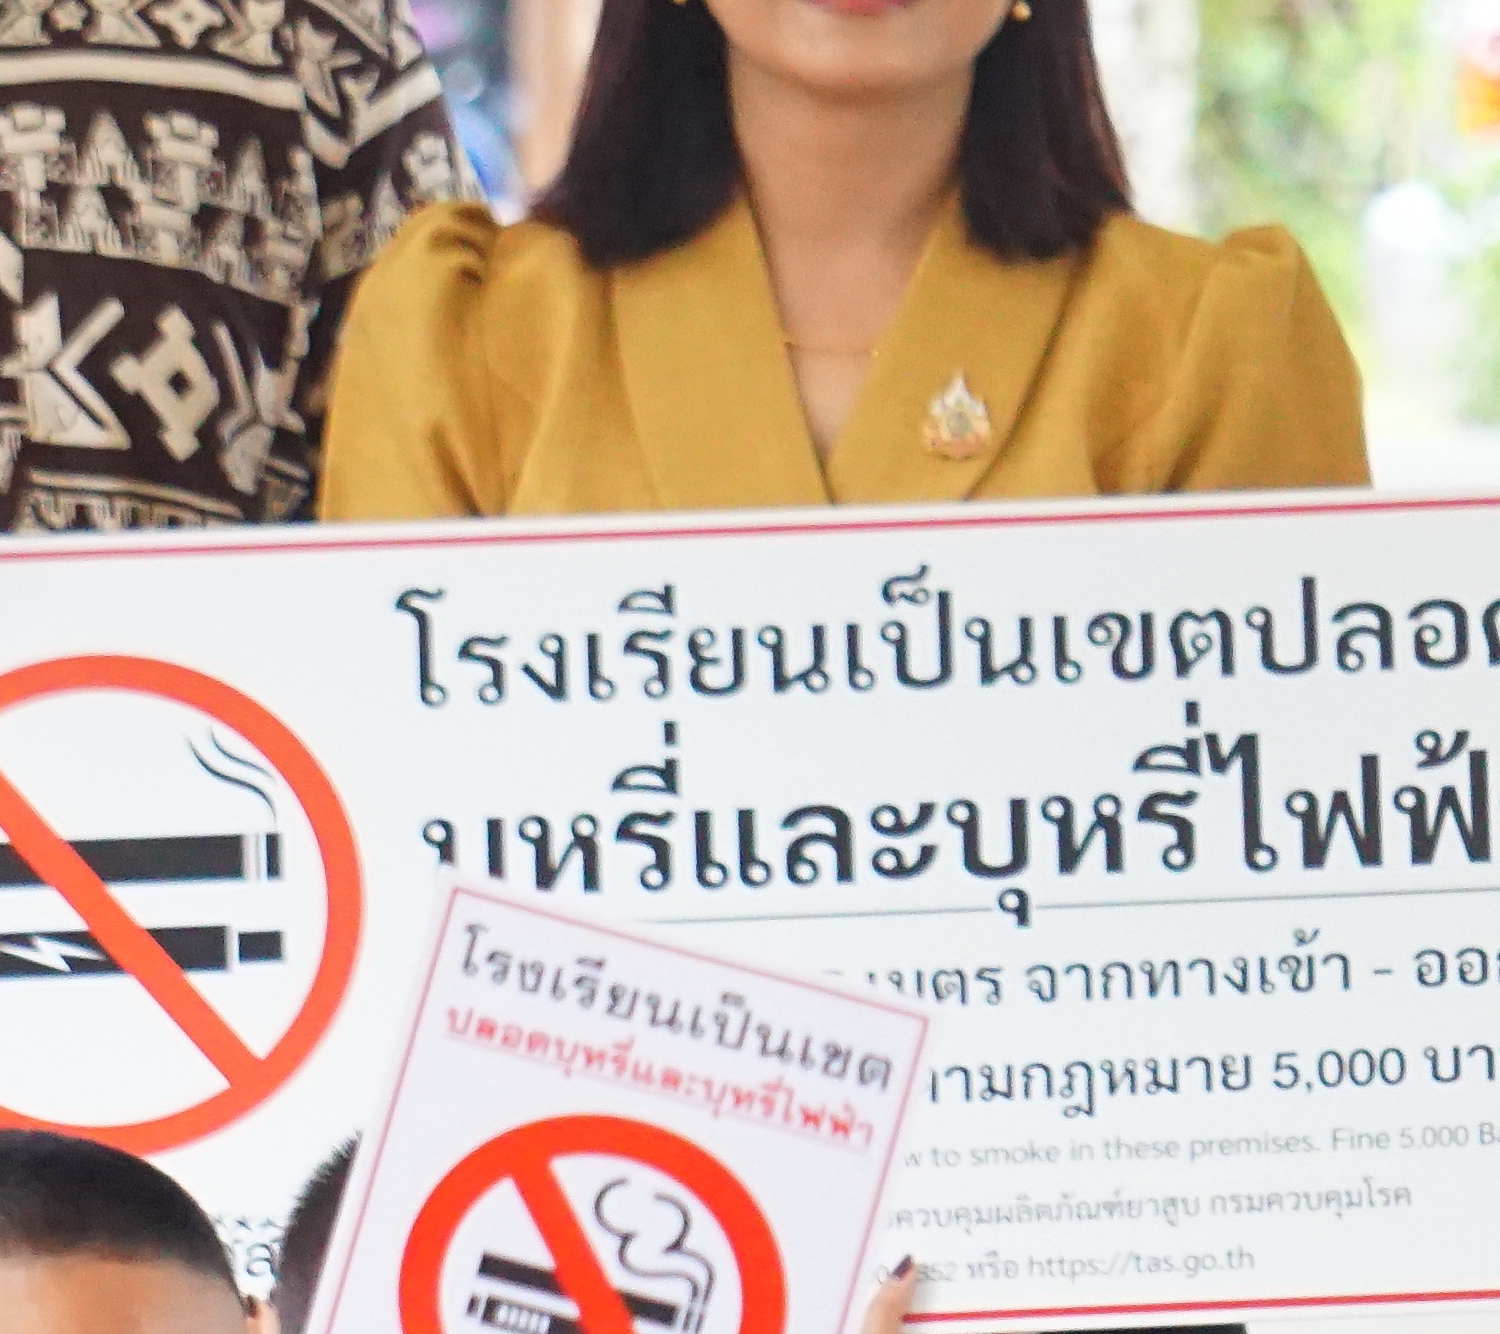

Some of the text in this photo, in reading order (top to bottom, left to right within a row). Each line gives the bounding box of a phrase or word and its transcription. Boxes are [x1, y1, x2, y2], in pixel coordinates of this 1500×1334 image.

[1026, 928, 1352, 1005] จากทางเข้า
[1272, 1046, 1408, 1094] 5,000
[930, 1145, 961, 1168] to
[970, 1140, 1061, 1166] smoke
[1070, 1138, 1094, 1162] in
[1103, 1135, 1181, 1161] these
[1332, 1126, 1391, 1152] Fine
